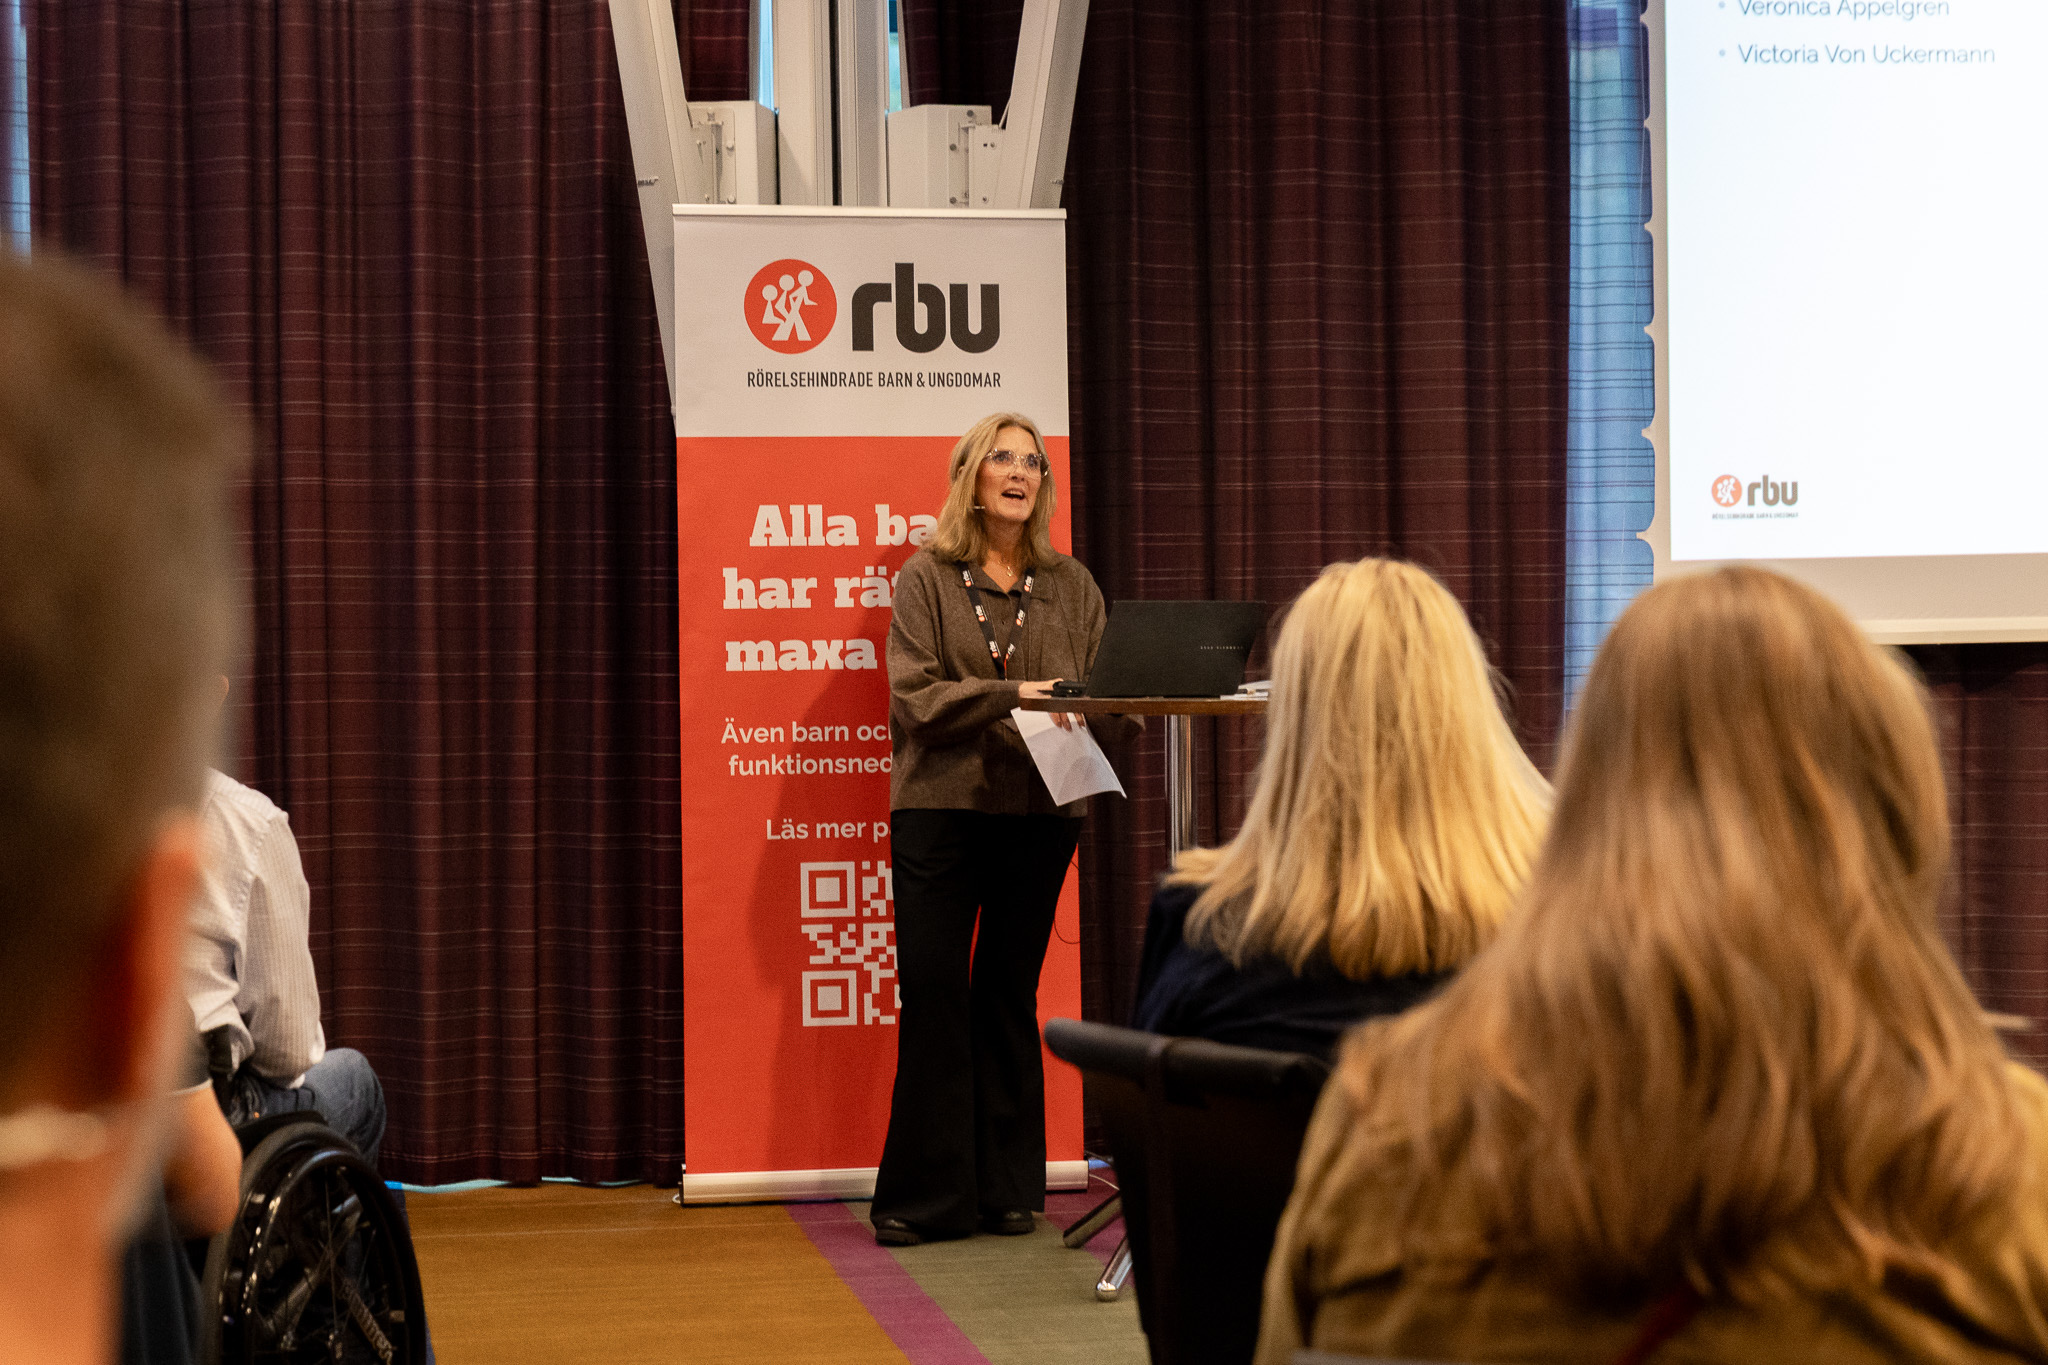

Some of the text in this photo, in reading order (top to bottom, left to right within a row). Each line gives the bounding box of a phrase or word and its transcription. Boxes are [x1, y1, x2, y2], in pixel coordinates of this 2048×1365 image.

[1739, 0, 1950, 21] Veronica Appelgren
[1738, 44, 1996, 64] Victoria Von Uckermann
[851, 262, 1001, 354] rbu
[747, 369, 1001, 388] RÖRELSEHINDRADE BARN & UNGDOMAR
[1747, 474, 1799, 506] rbu
[749, 504, 860, 547] Alla
[722, 567, 818, 610] har
[725, 638, 878, 672] maxa
[721, 717, 785, 744] Även
[792, 721, 849, 742] barn
[766, 818, 891, 843] Läs mer p
